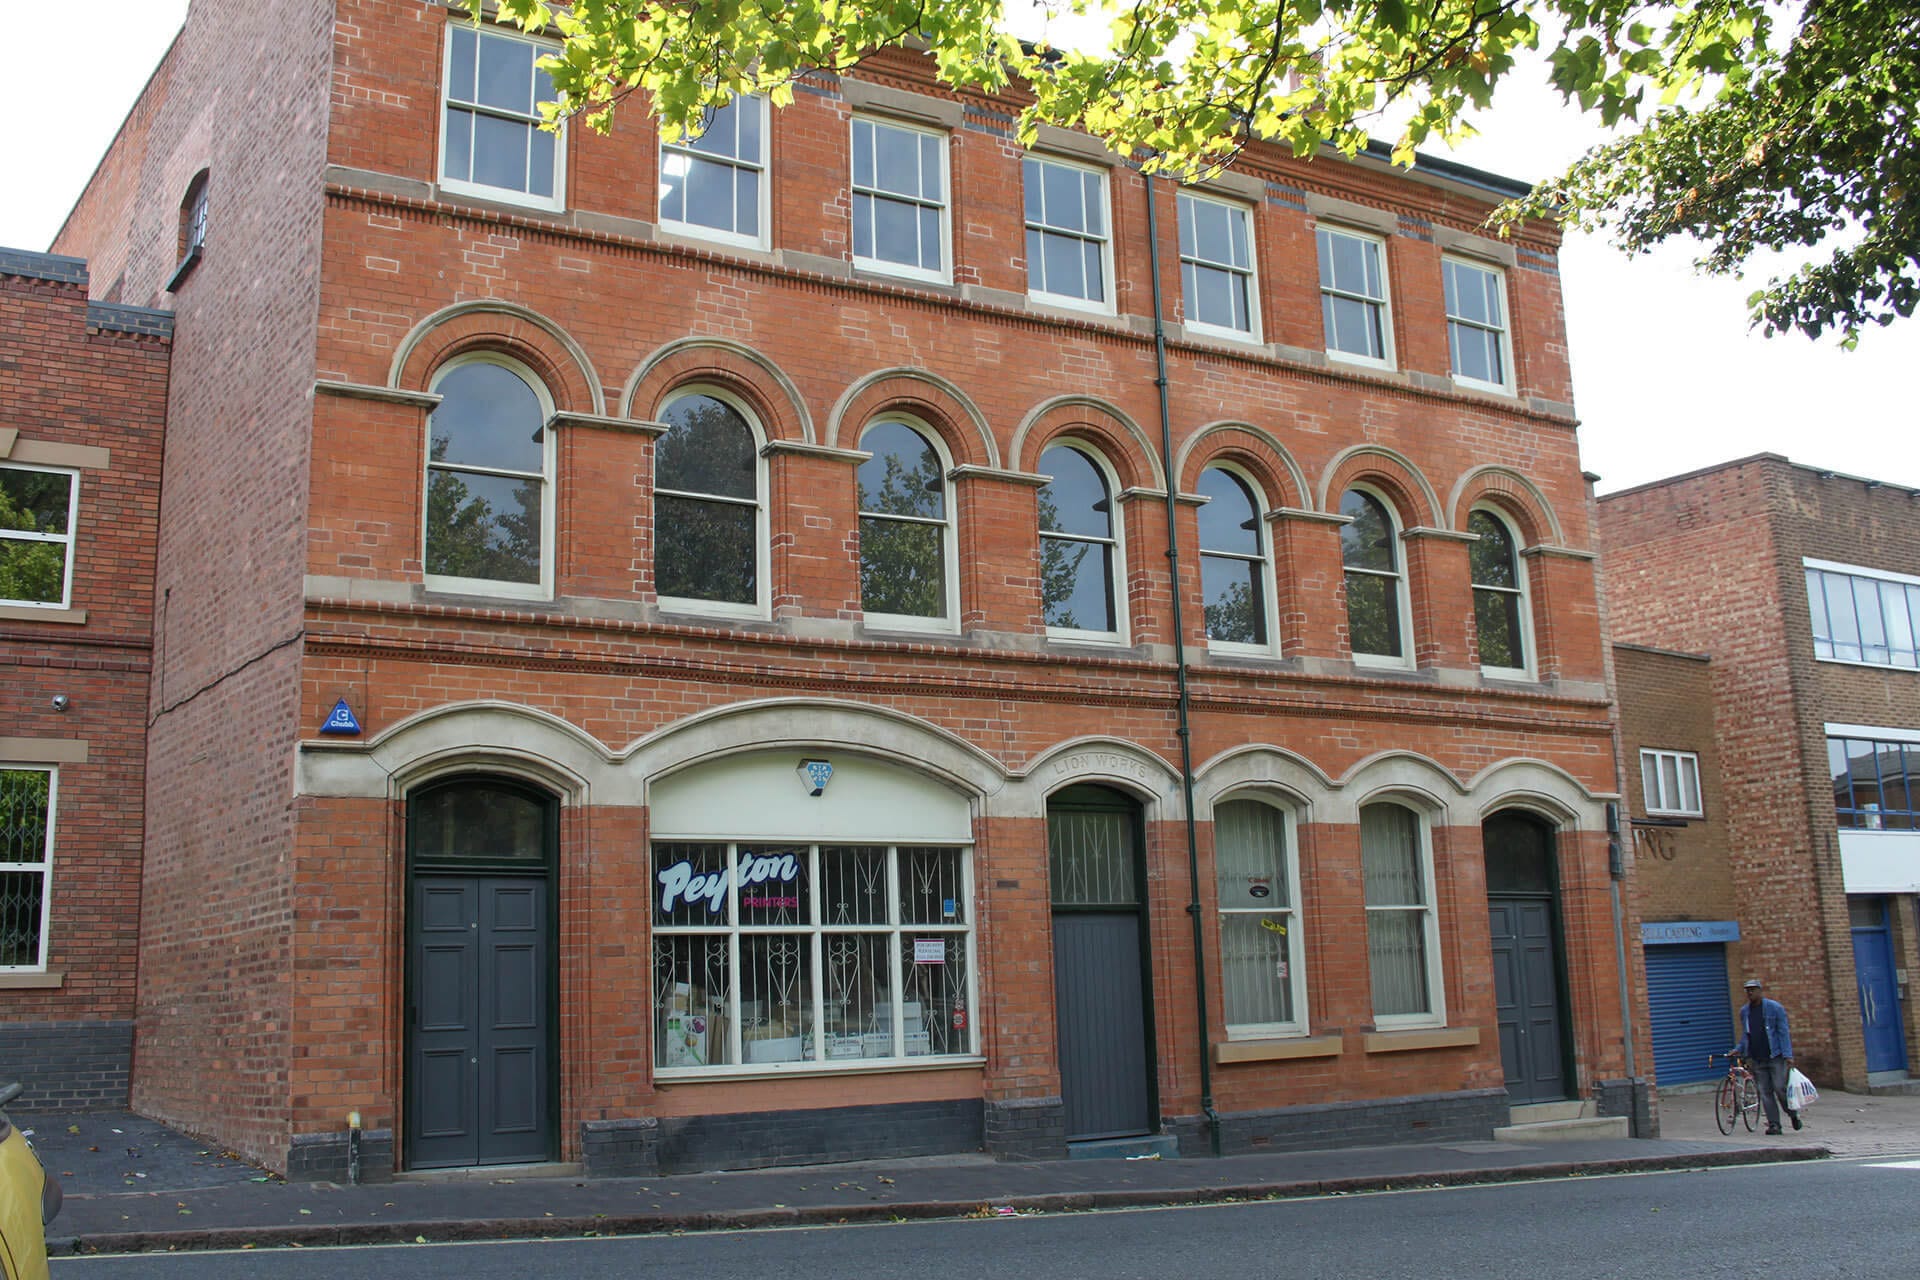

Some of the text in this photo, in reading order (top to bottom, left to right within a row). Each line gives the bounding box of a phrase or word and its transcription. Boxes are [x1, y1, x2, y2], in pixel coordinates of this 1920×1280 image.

[330, 720, 354, 728] Chubb
[1053, 754, 1147, 778] LION WORKS
[658, 852, 799, 914] Peyton
[743, 896, 799, 908] PRINTERS
